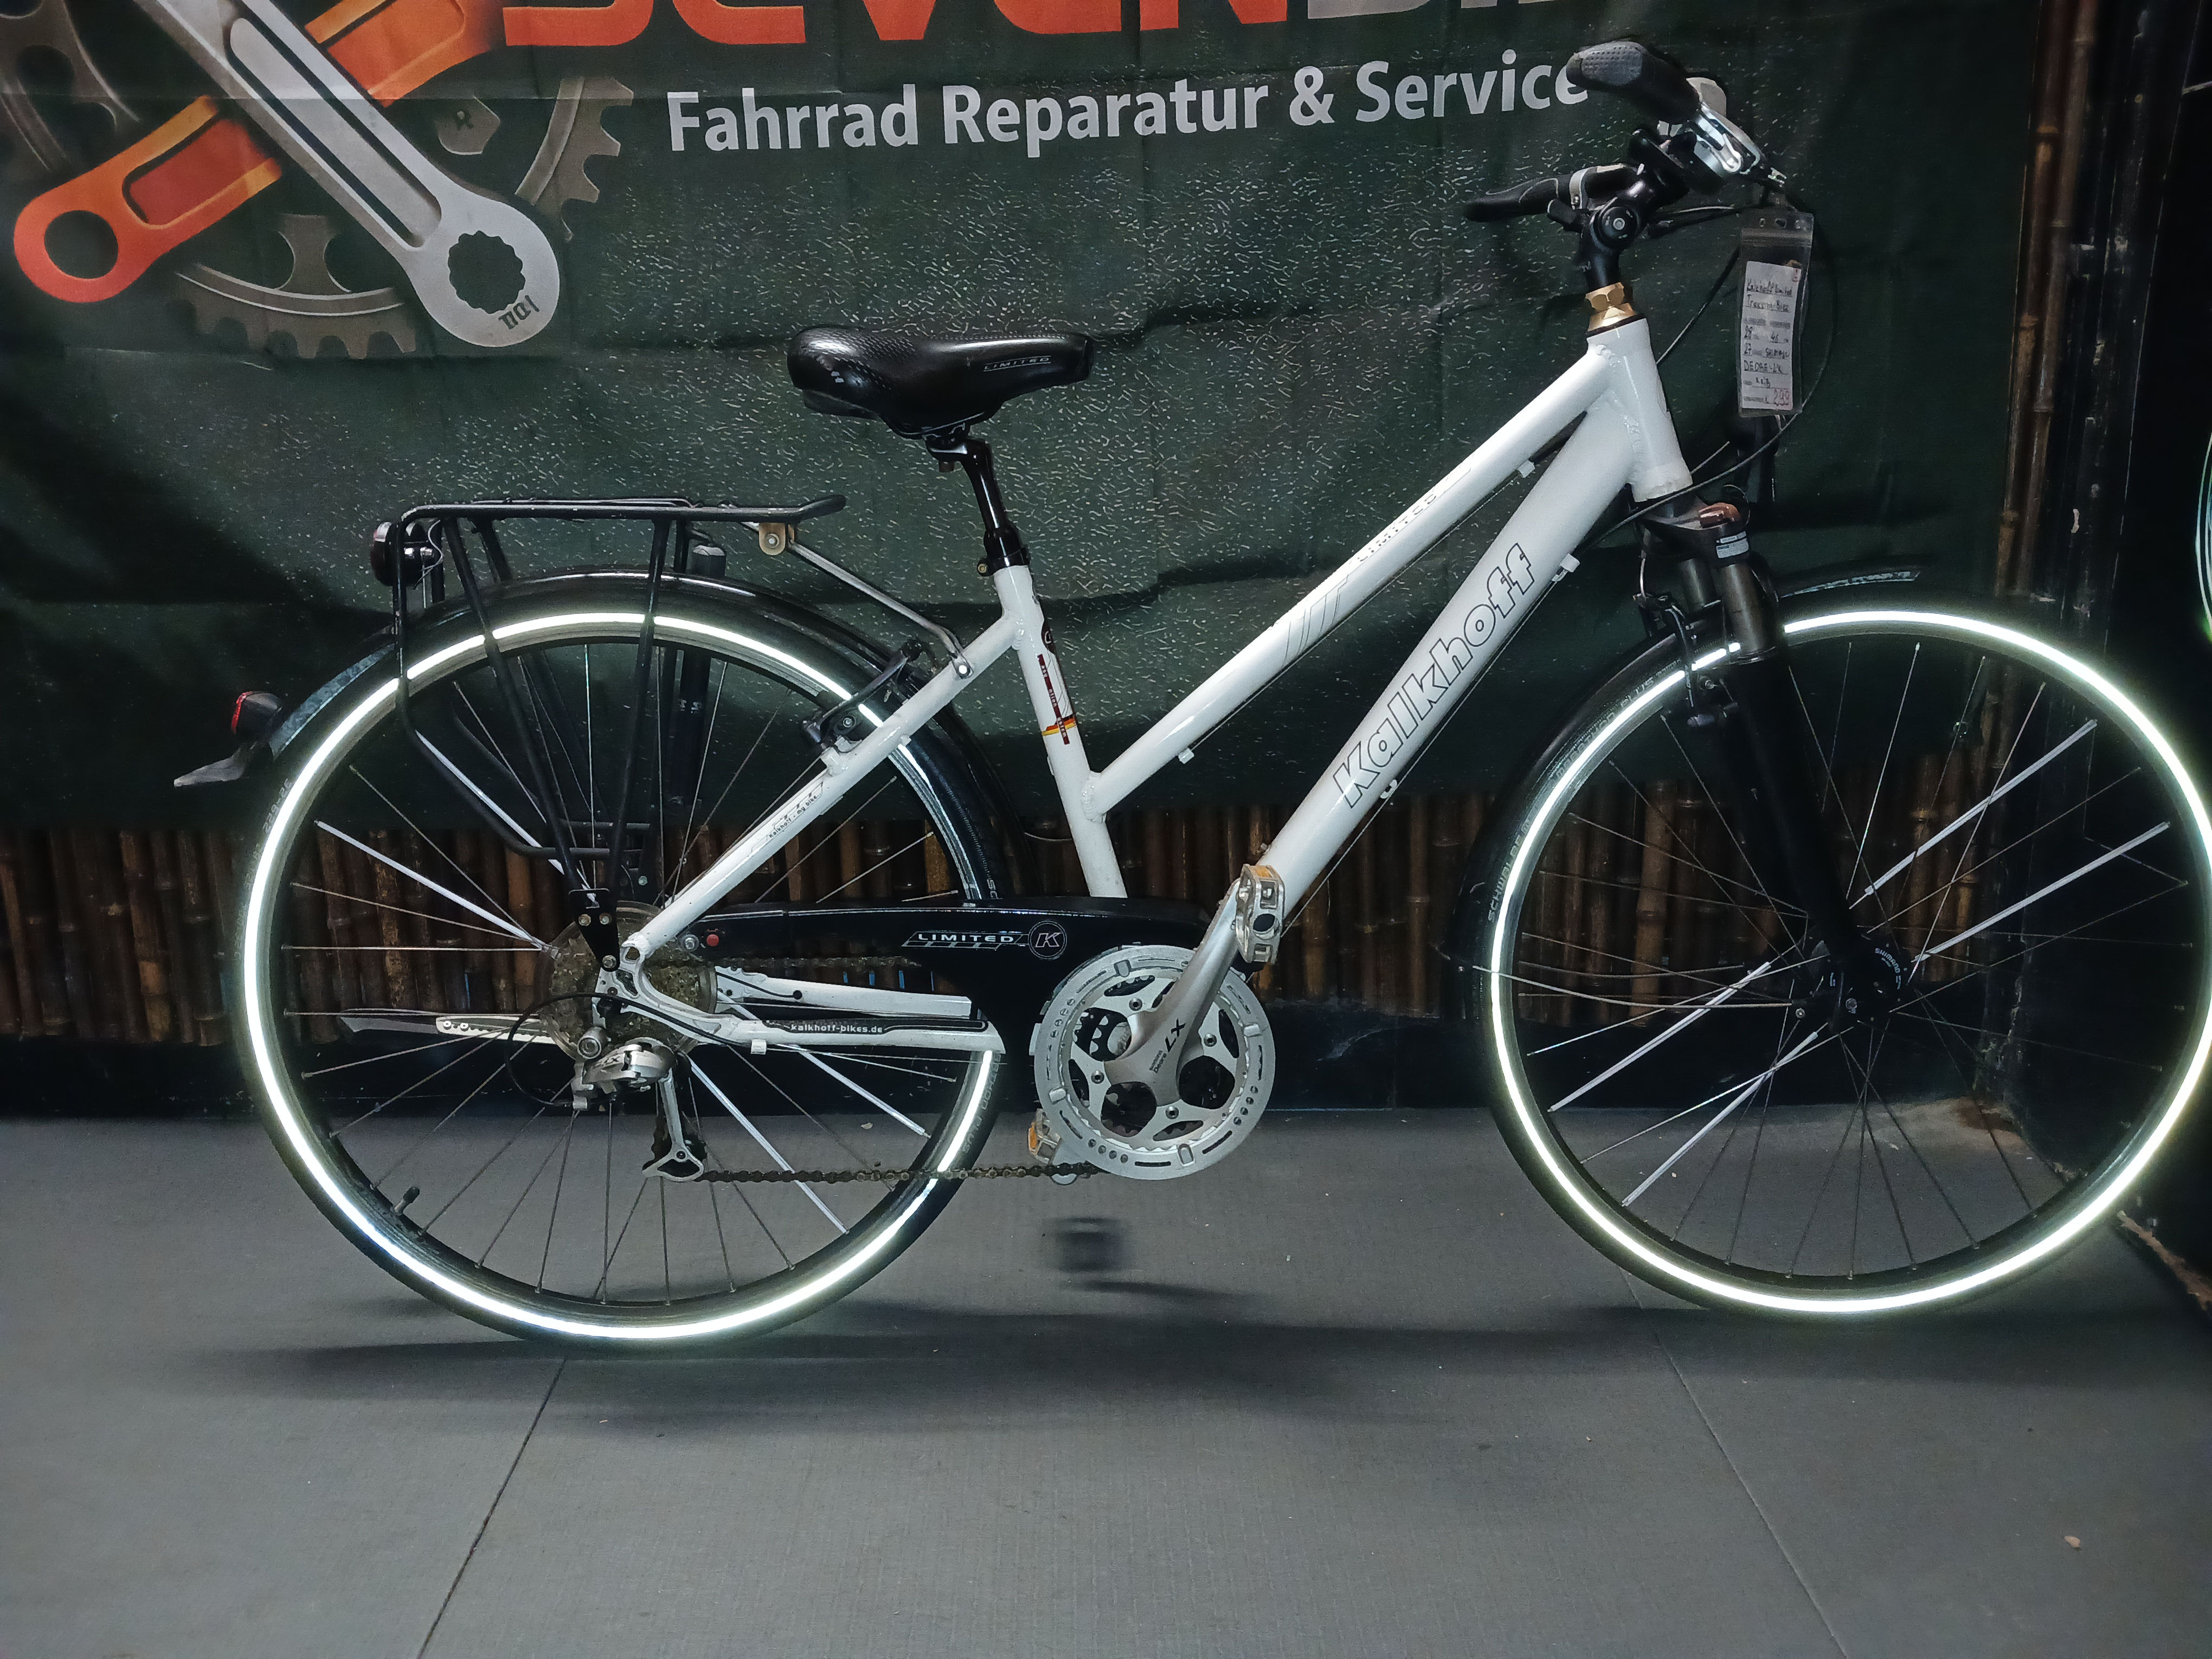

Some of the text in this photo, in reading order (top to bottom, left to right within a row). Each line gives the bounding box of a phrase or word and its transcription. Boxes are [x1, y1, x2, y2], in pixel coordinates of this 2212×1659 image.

[667, 49, 1589, 158] Fahrrad Reparatur & Service
[1332, 542, 1535, 808] Kalkhoff
[796, 807, 806, 815] my
[806, 795, 817, 806] bike
[918, 934, 1014, 942] LIMITED
[791, 1024, 883, 1033] kalkhoff-bikes.de
[1165, 1018, 1186, 1052] LX
